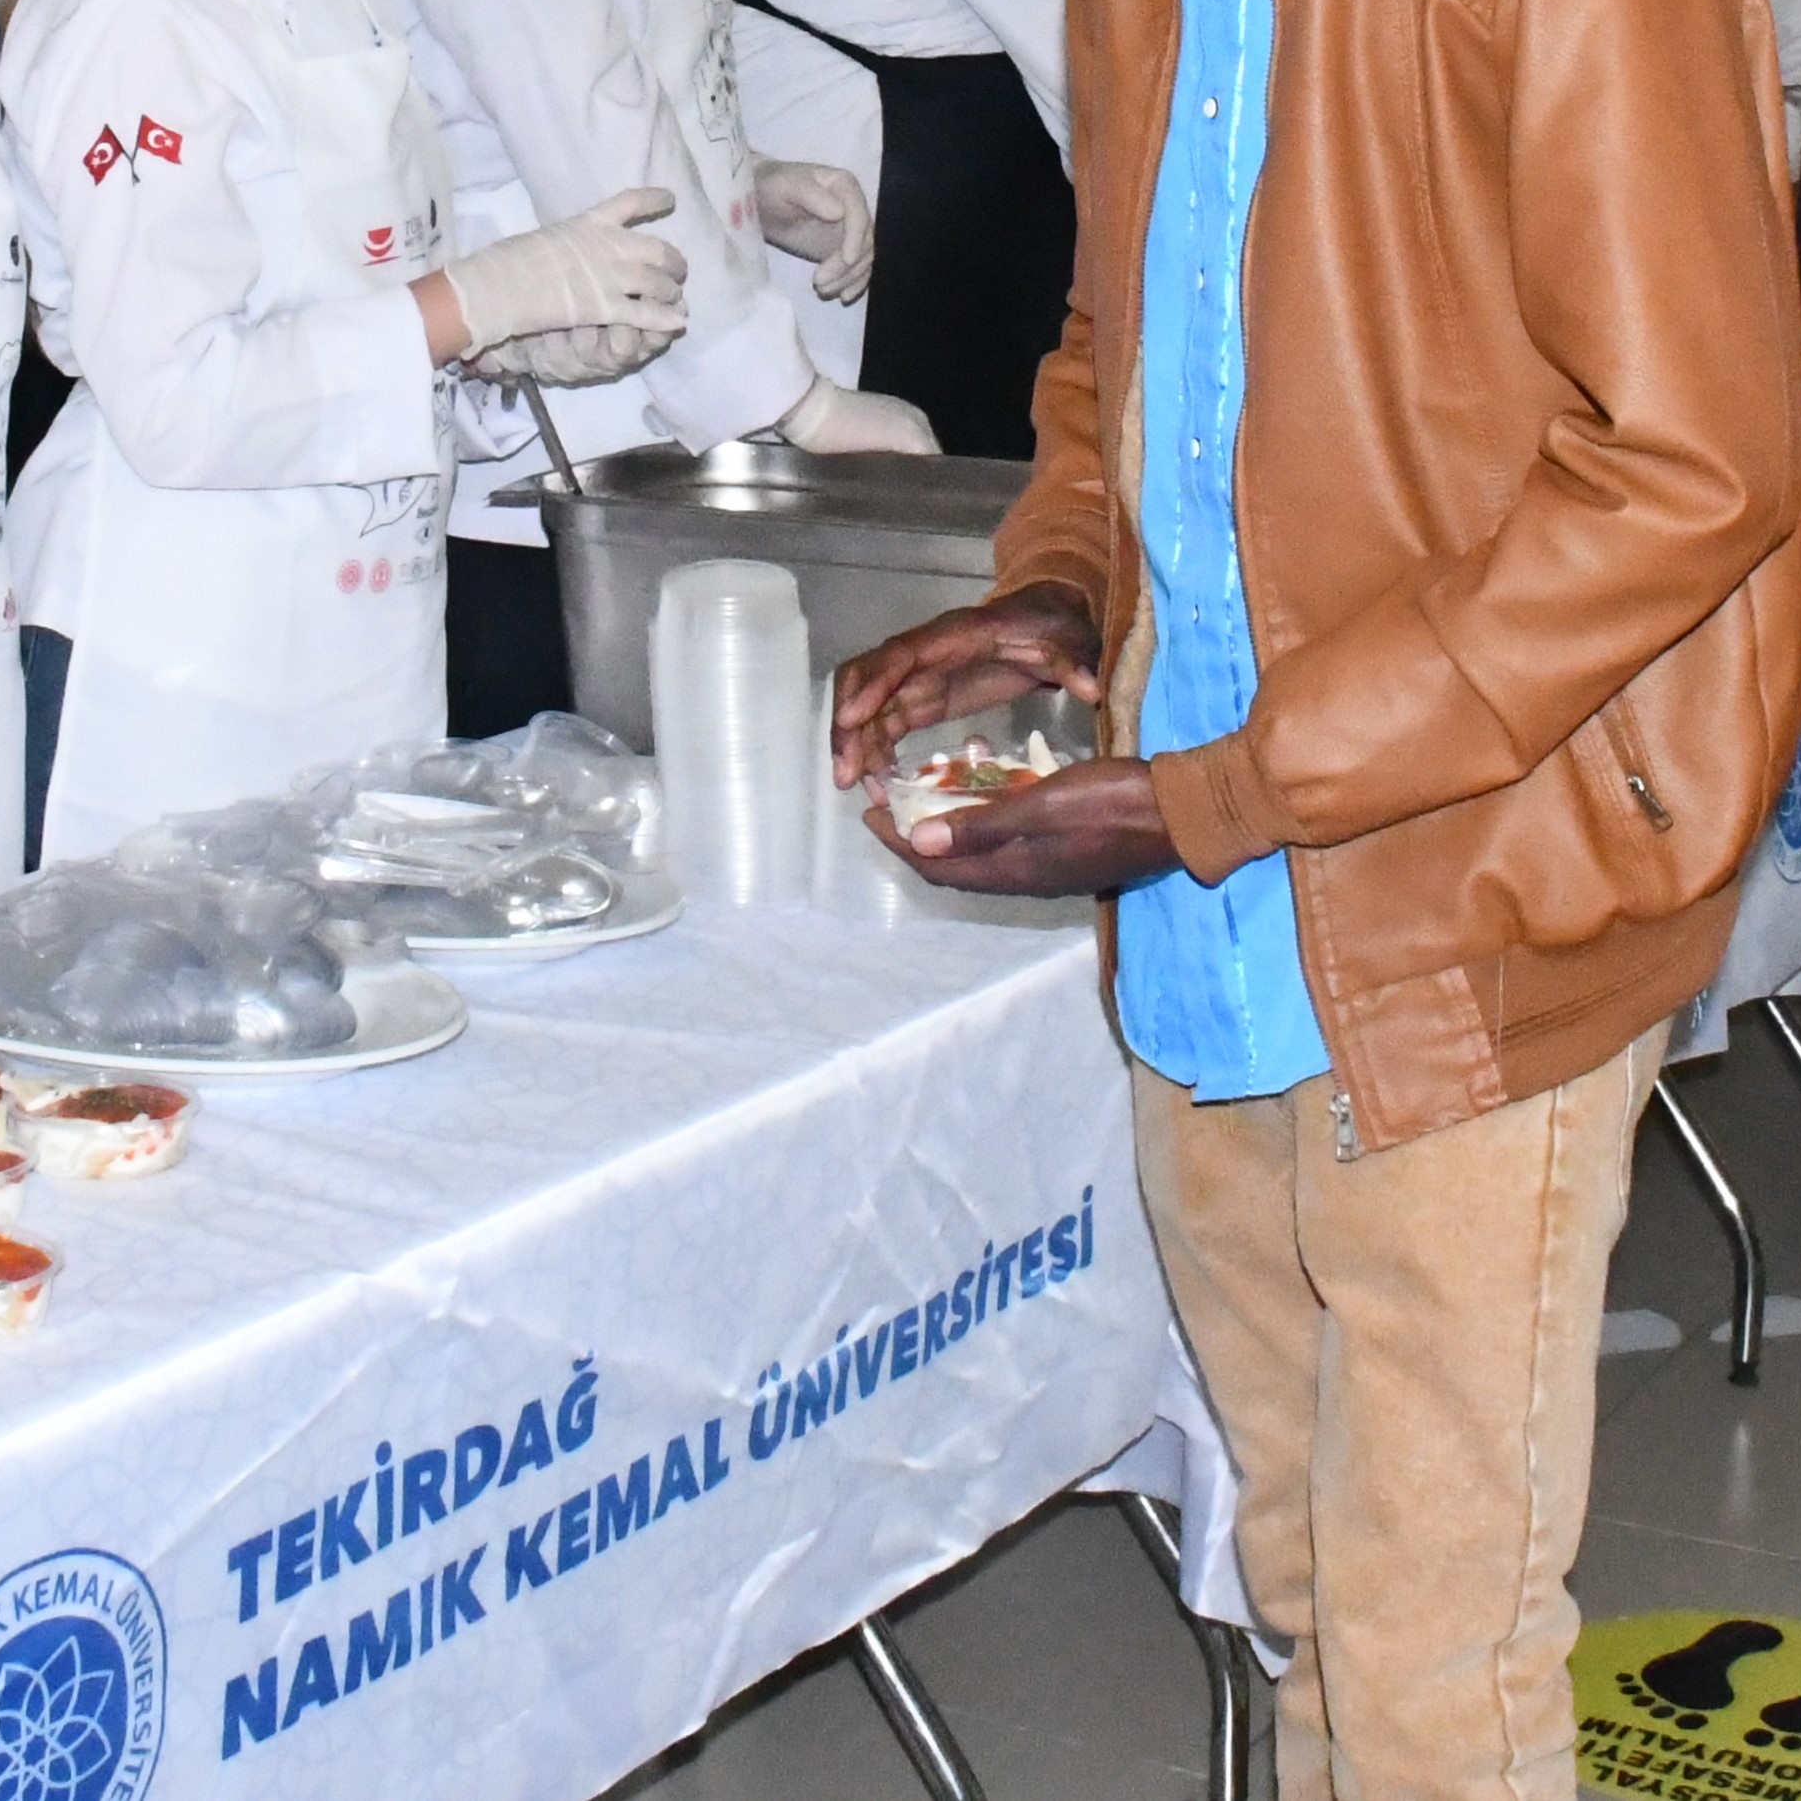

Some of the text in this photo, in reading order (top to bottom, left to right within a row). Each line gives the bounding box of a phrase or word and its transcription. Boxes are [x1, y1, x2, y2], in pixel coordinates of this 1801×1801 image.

[12, 1570, 115, 1622] KEMAL
[221, 1185, 1096, 1760] NAMIK KEMAL ÜNİVERSİTESİ
[225, 1350, 600, 1625] TEKİRDAĞ
